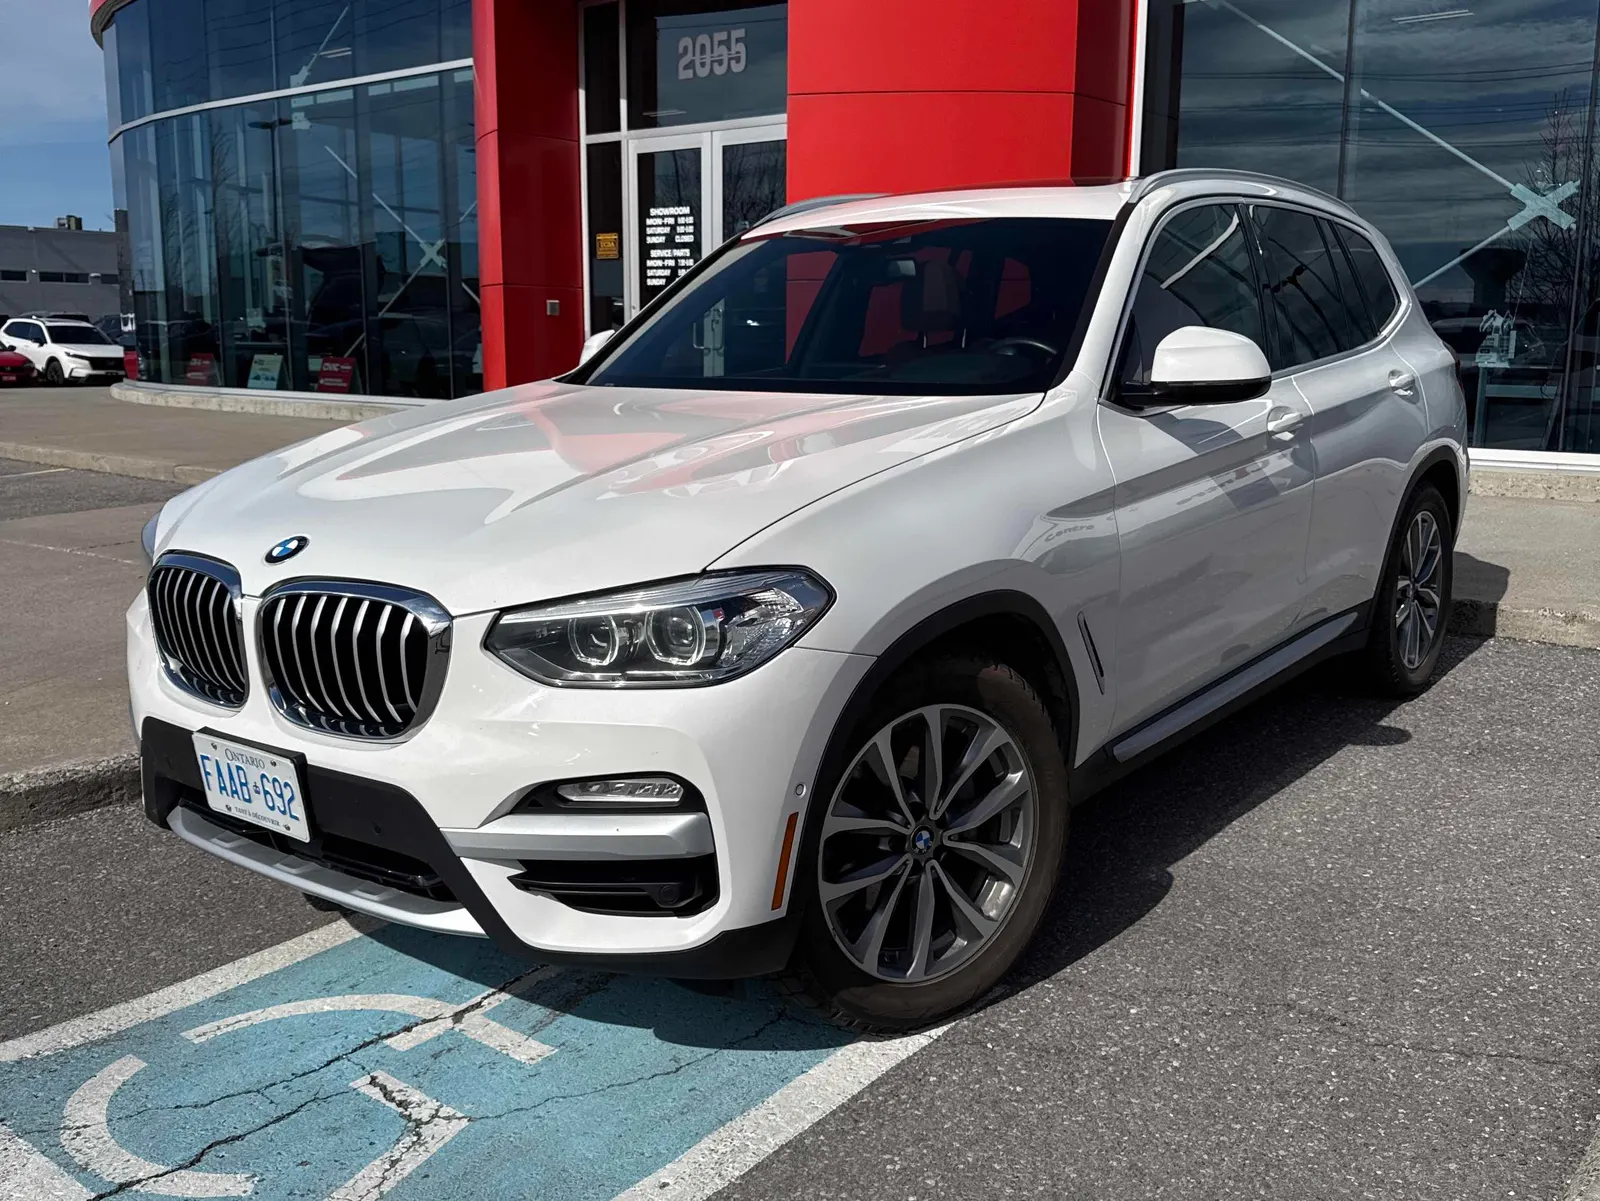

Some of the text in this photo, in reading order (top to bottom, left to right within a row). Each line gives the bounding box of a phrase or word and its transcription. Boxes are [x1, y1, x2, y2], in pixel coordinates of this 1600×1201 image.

[678, 28, 746, 80] 2055
[650, 206, 690, 216] SHOWROOM
[646, 217, 675, 226] MON-FRI
[646, 259, 675, 267] MON-FRI
[224, 748, 266, 769] ONTARIO
